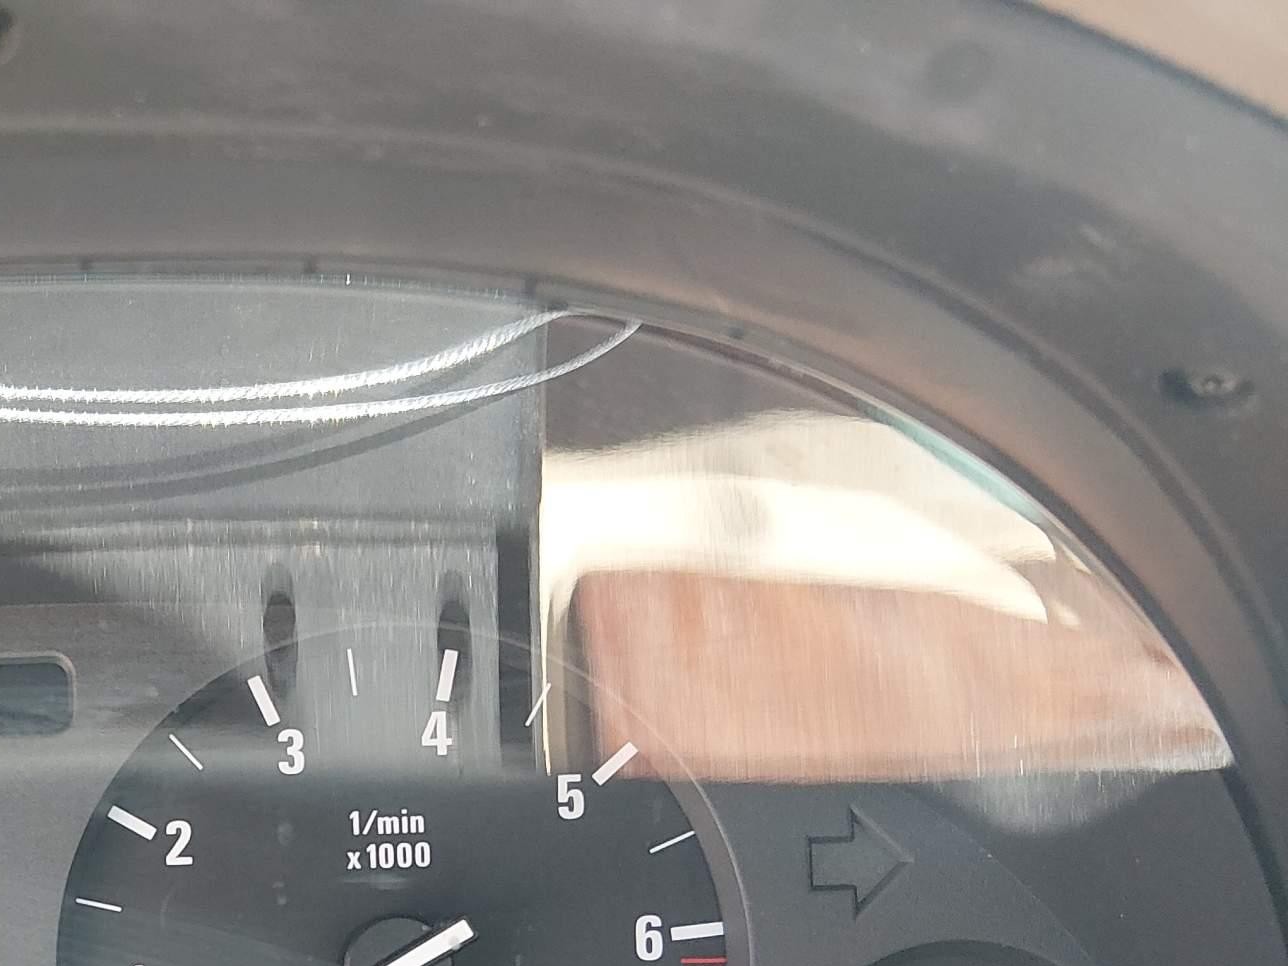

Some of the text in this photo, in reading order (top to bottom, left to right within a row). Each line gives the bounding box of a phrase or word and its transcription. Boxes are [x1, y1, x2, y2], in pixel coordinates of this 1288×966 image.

[276, 729, 305, 774] 3
[421, 711, 453, 755] 4
[557, 773, 584, 820] 5
[165, 821, 193, 866] 2
[349, 810, 425, 834] 1/min
[635, 915, 663, 961] 6
